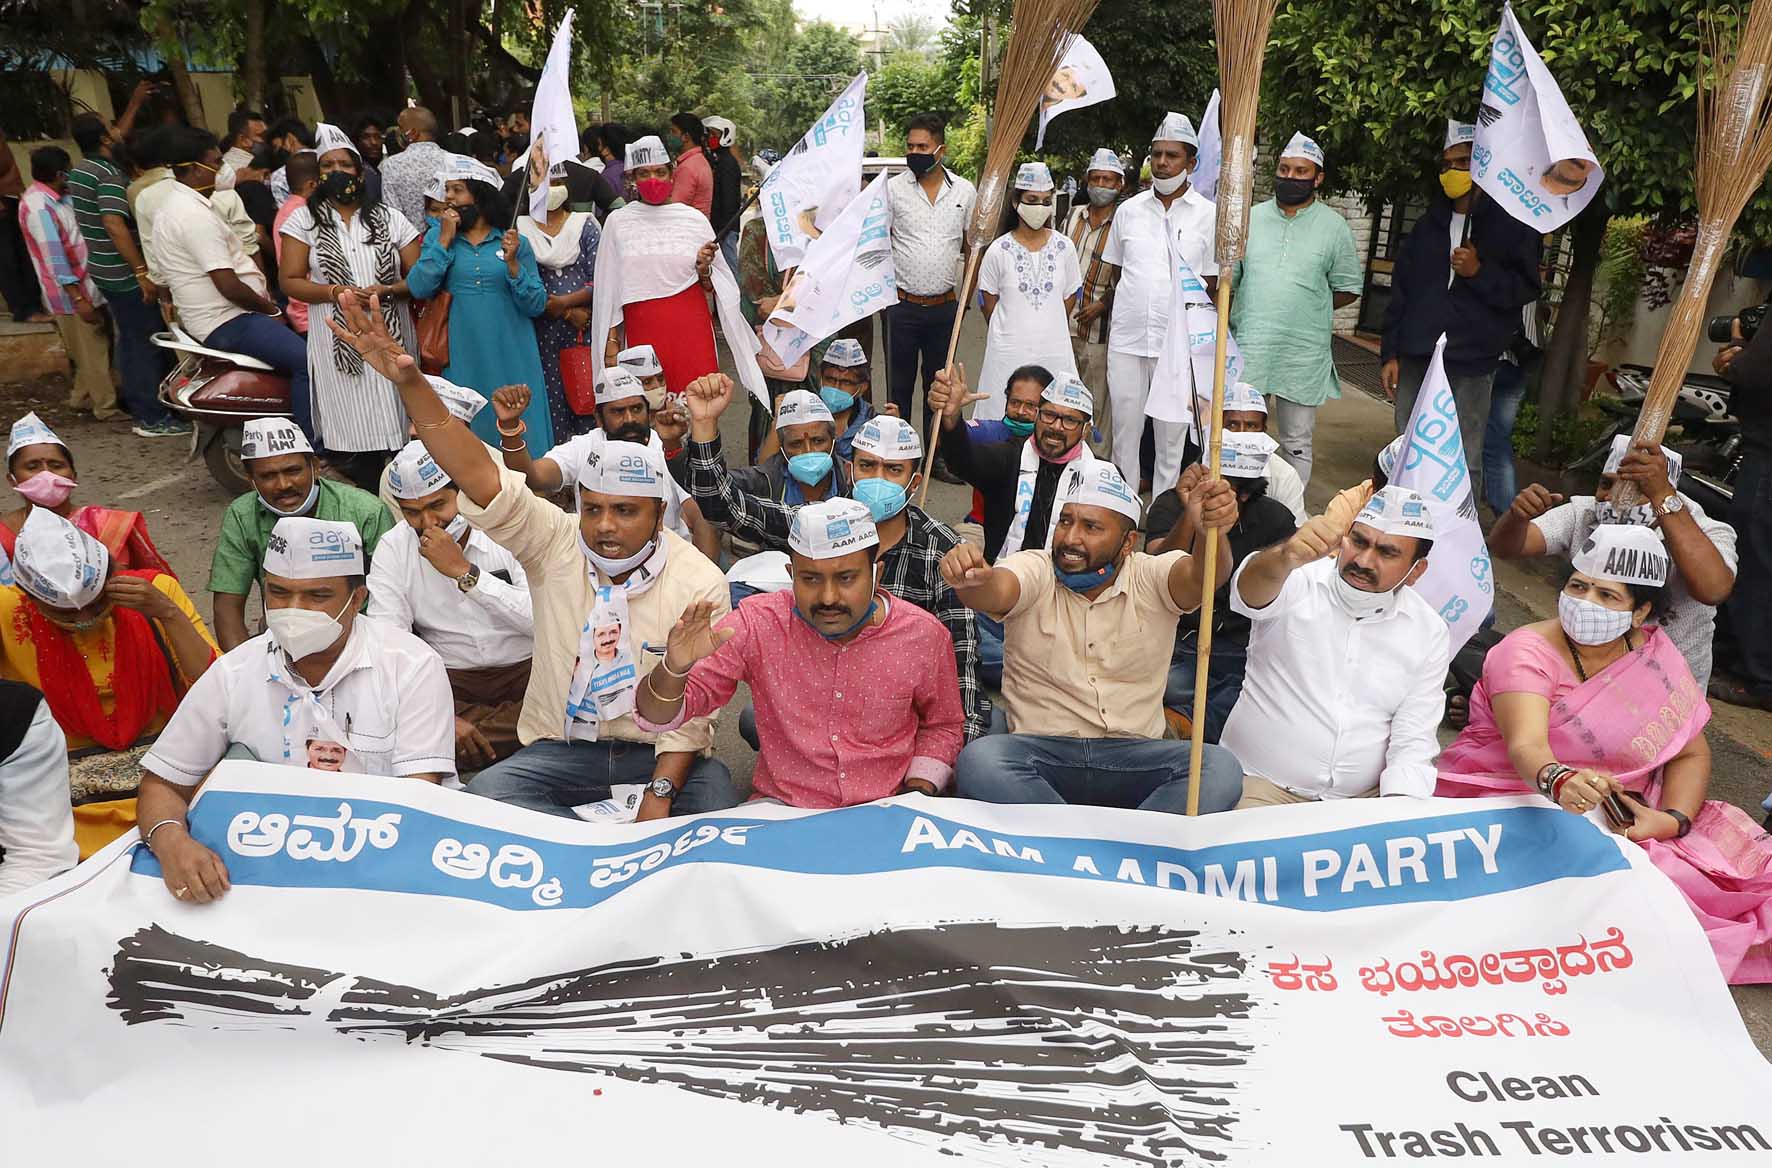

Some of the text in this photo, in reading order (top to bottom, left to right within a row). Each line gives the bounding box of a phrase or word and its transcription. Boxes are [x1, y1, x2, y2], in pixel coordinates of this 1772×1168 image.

[244, 430, 263, 442] Party
[427, 474, 446, 488] AAM
[1404, 519, 1424, 529] AAM
[832, 537, 856, 549] AAM
[1603, 547, 1638, 578] AAM
[226, 801, 752, 907] ಆಮ್ ಆದ್ಮಿ ಪಾರ್ಟಿ
[1302, 824, 1503, 897] PARTY
[1267, 926, 1634, 997] ಕಸ ಭಯೋತ್ಪಾದನೆ
[1381, 1009, 1571, 1038] ತೊಲಗಿಸಿ
[1446, 1069, 1600, 1103] Clean
[1338, 1116, 1771, 1158] Trash Terrorism
